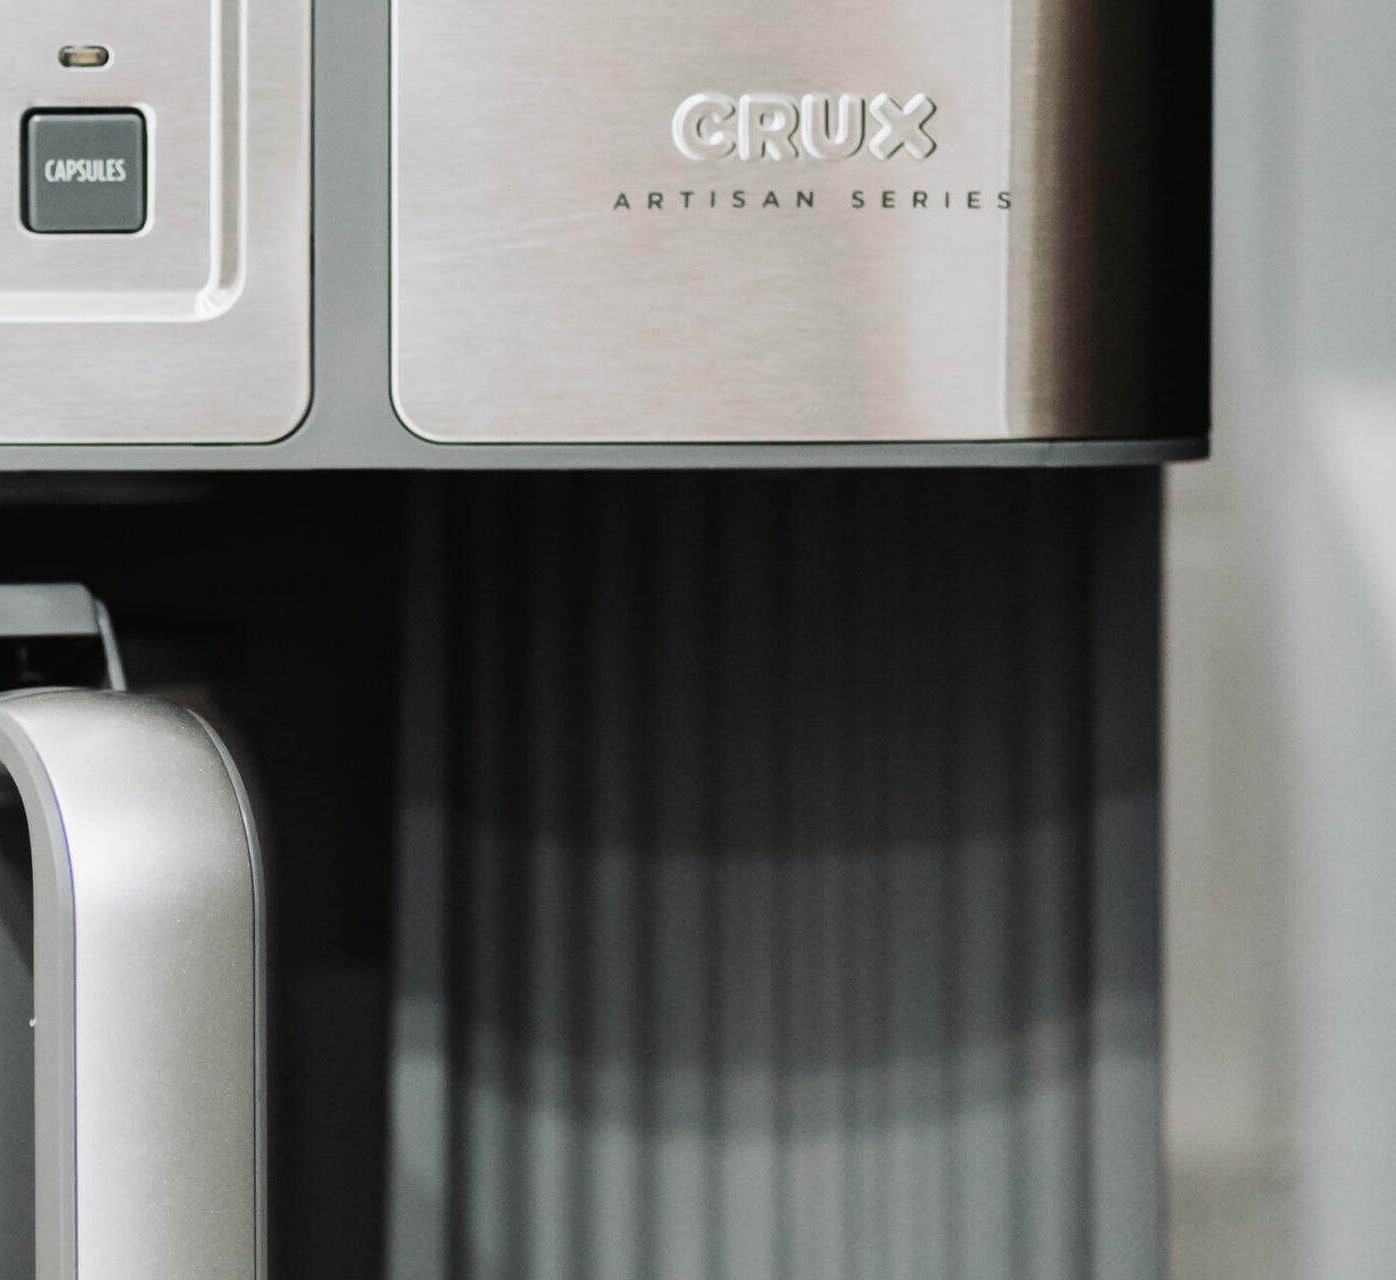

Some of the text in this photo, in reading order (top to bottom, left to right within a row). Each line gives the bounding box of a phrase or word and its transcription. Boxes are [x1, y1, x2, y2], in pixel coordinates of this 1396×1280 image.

[671, 91, 937, 162] CRUX
[44, 159, 126, 183] CAPSULES
[613, 190, 1012, 210] ARTISAN SERIES
